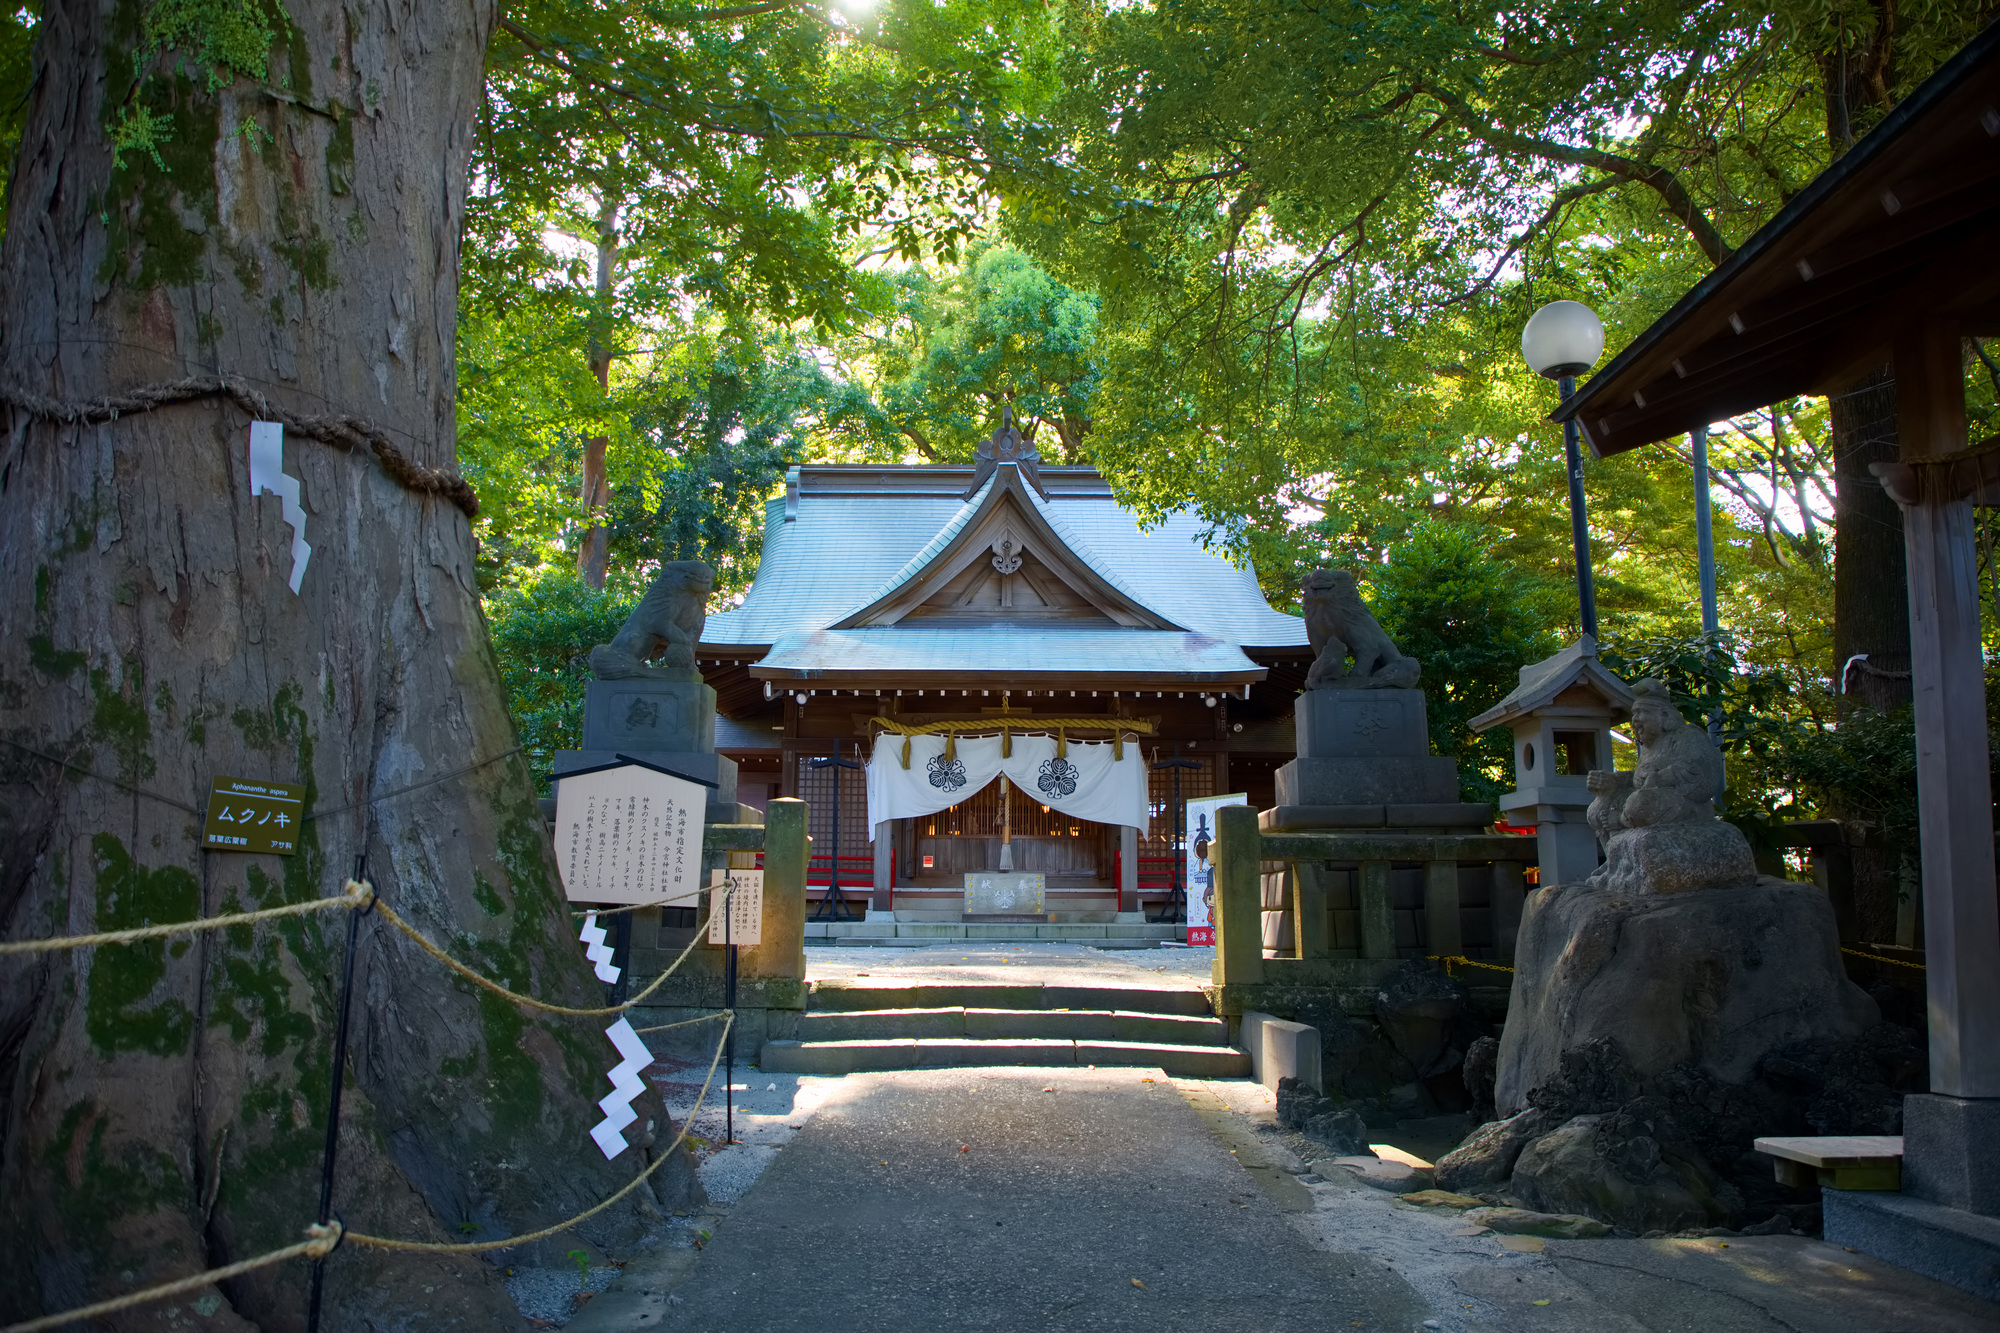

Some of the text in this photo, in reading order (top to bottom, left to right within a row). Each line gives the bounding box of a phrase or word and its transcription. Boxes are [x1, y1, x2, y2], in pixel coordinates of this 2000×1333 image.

[231, 782, 289, 796] Aphananthe aspera
[217, 805, 291, 829] ムクノキ
[664, 799, 674, 837] 天然記念物
[270, 840, 293, 850] アサ科
[568, 822, 580, 886] 熱海市教育委員会
[674, 808, 687, 884] 熱海市指定文化財
